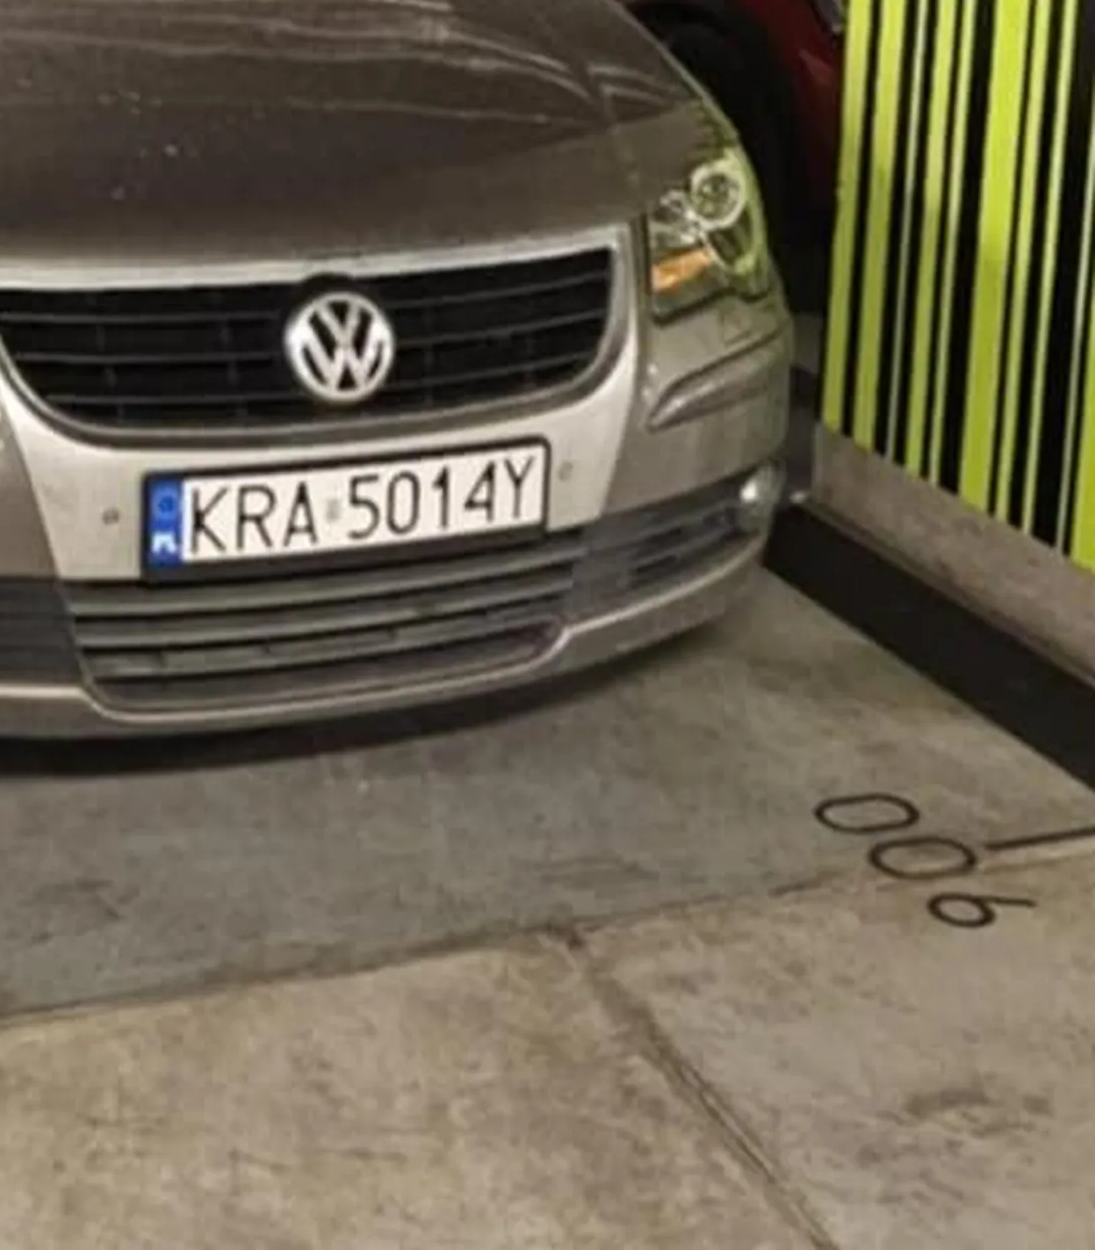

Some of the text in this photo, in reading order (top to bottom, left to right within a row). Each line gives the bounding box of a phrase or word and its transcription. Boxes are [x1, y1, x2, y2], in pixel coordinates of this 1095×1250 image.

[286, 293, 394, 401] VW
[190, 455, 536, 555] KRA 5014Y
